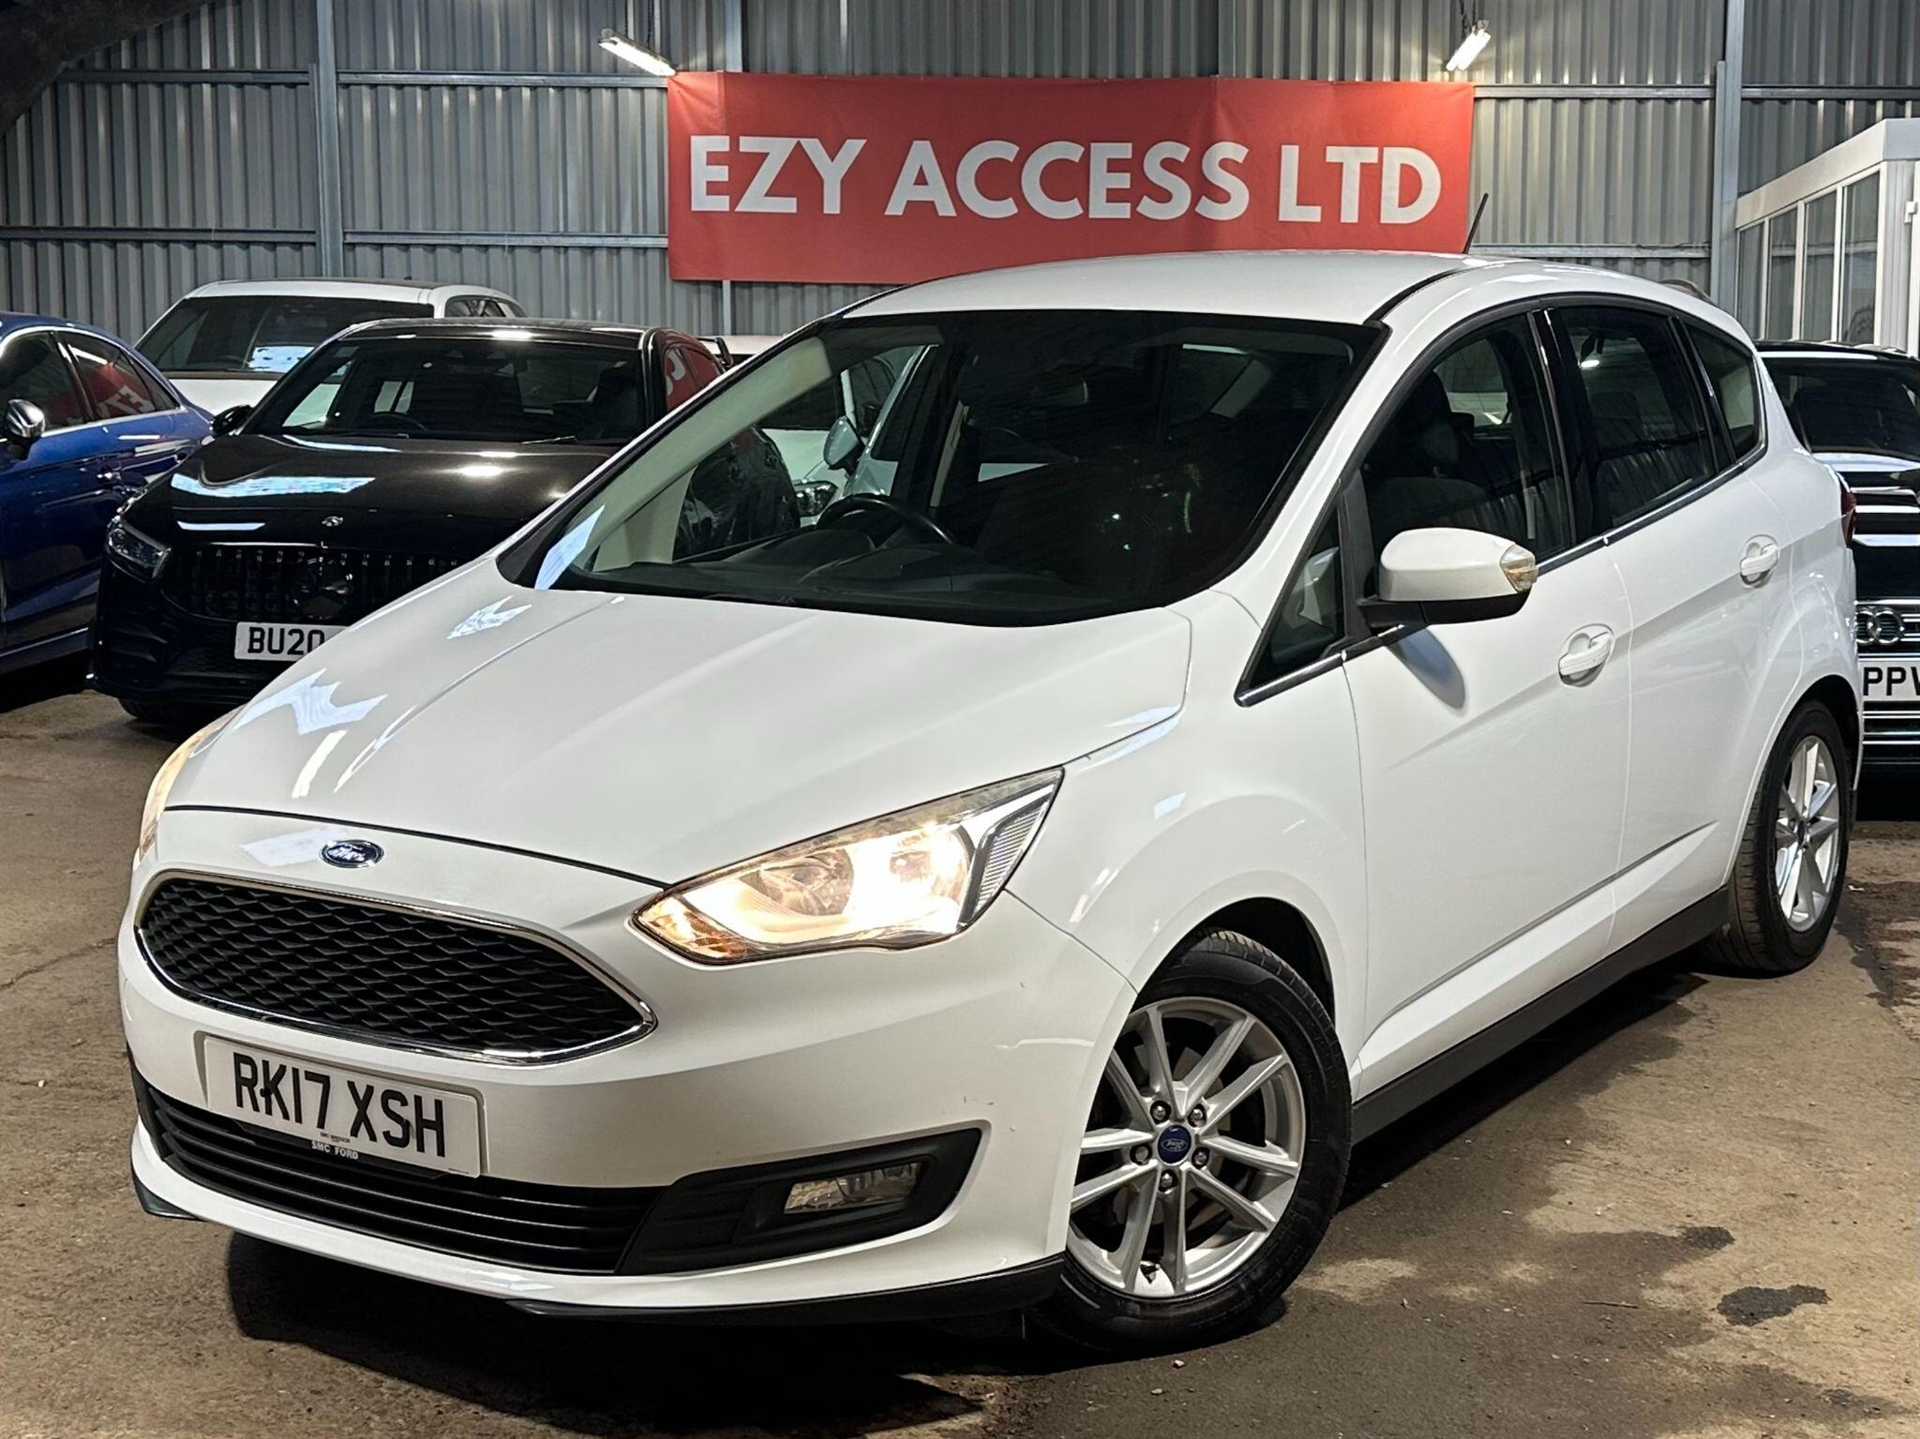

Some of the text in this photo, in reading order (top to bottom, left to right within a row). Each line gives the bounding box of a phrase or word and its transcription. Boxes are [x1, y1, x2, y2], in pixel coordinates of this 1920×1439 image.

[690, 135, 1442, 224] EZY ACCESS LTD
[247, 626, 325, 656] BU20
[233, 1051, 446, 1158] RK17 XSH
